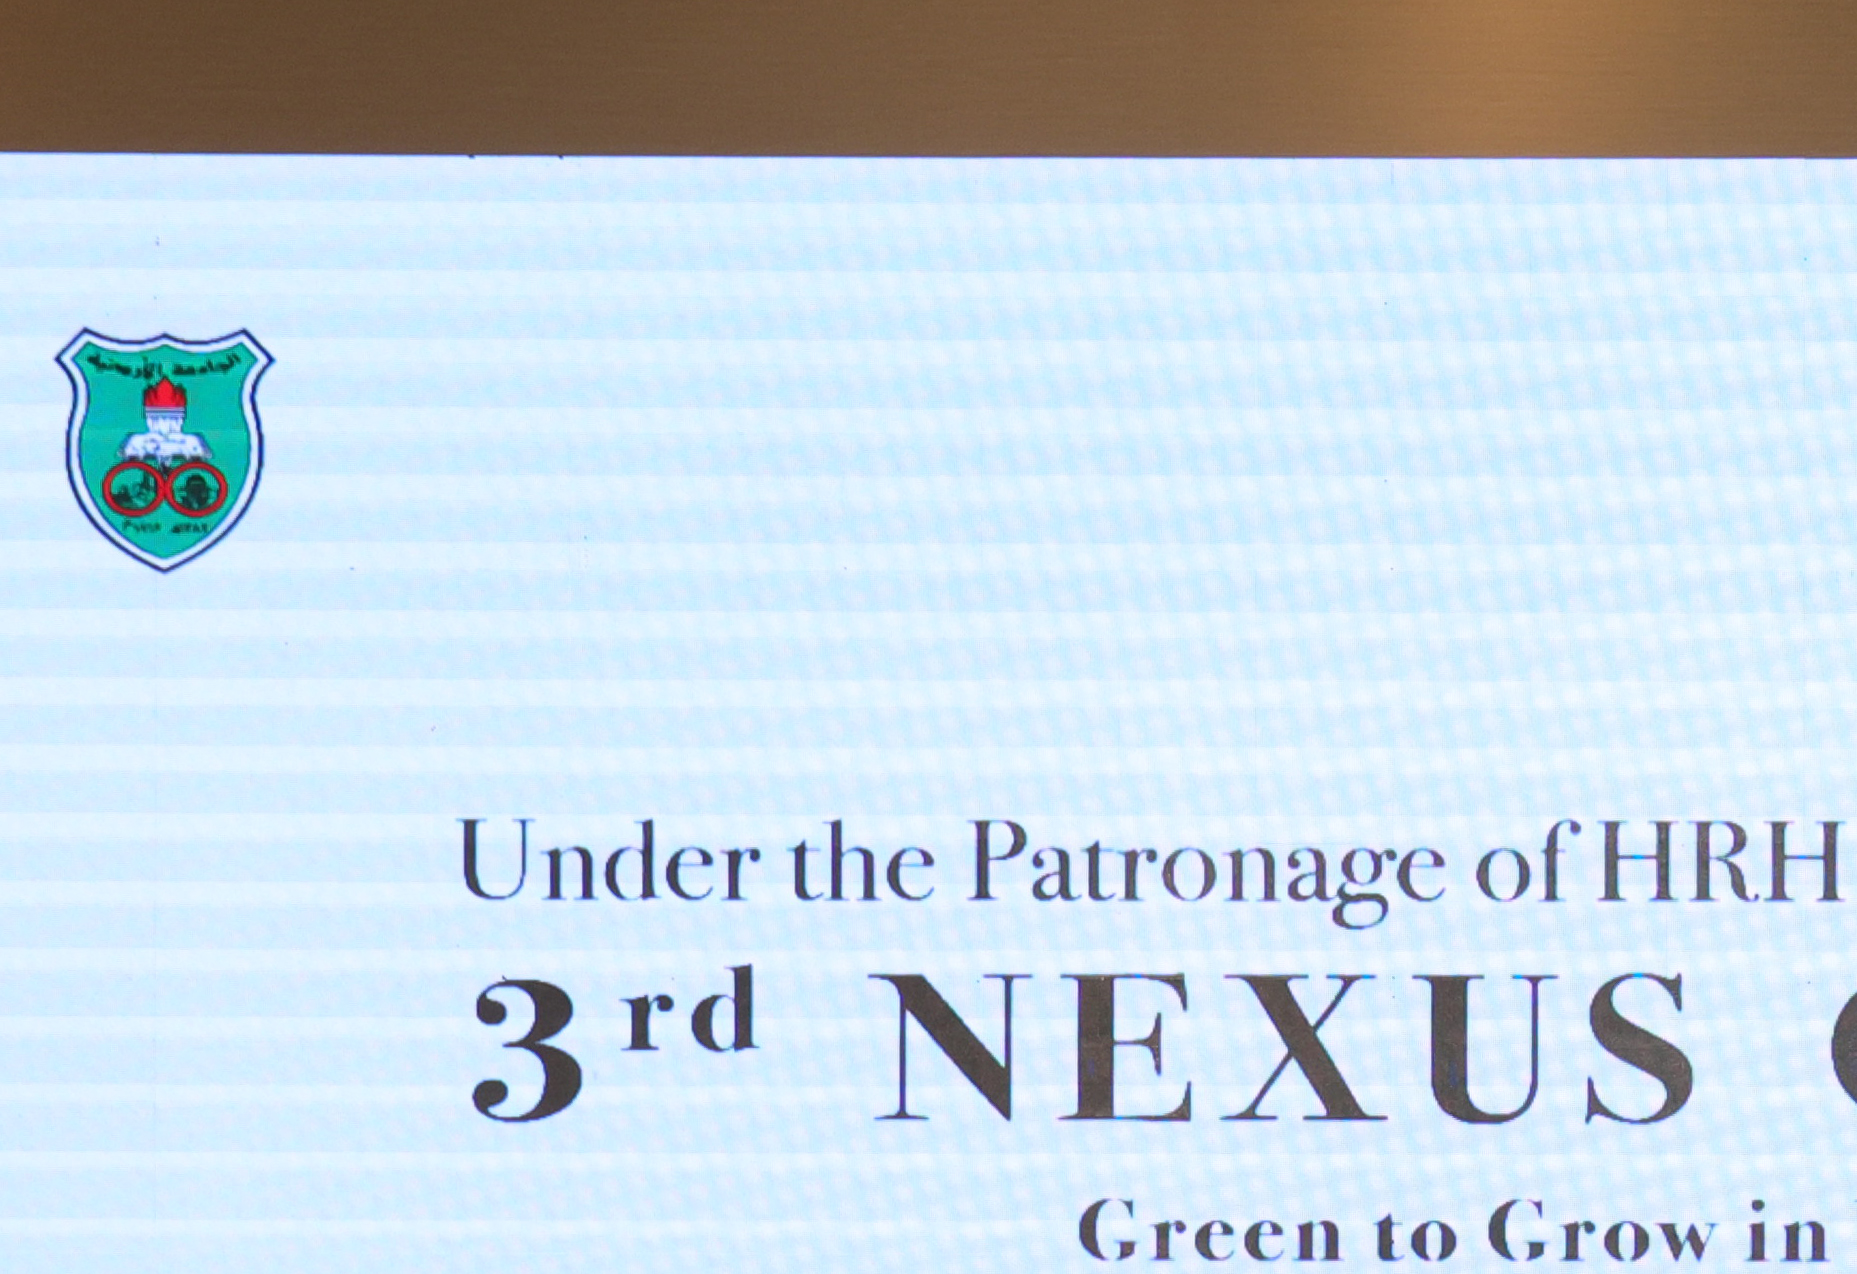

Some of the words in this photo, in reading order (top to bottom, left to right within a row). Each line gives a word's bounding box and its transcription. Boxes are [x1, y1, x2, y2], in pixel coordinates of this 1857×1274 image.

[461, 817, 762, 903] Under
[791, 818, 936, 903] the
[971, 819, 1446, 931] Patronage
[1475, 819, 1580, 903] of
[1596, 820, 1840, 903] HRH
[470, 962, 757, 1124] 3rd
[867, 972, 1694, 1126] NEXUS
[1077, 1198, 1341, 1263] Green
[1375, 1212, 1458, 1263] to
[1487, 1198, 1716, 1263] Grow
[1748, 1198, 1827, 1263] in
